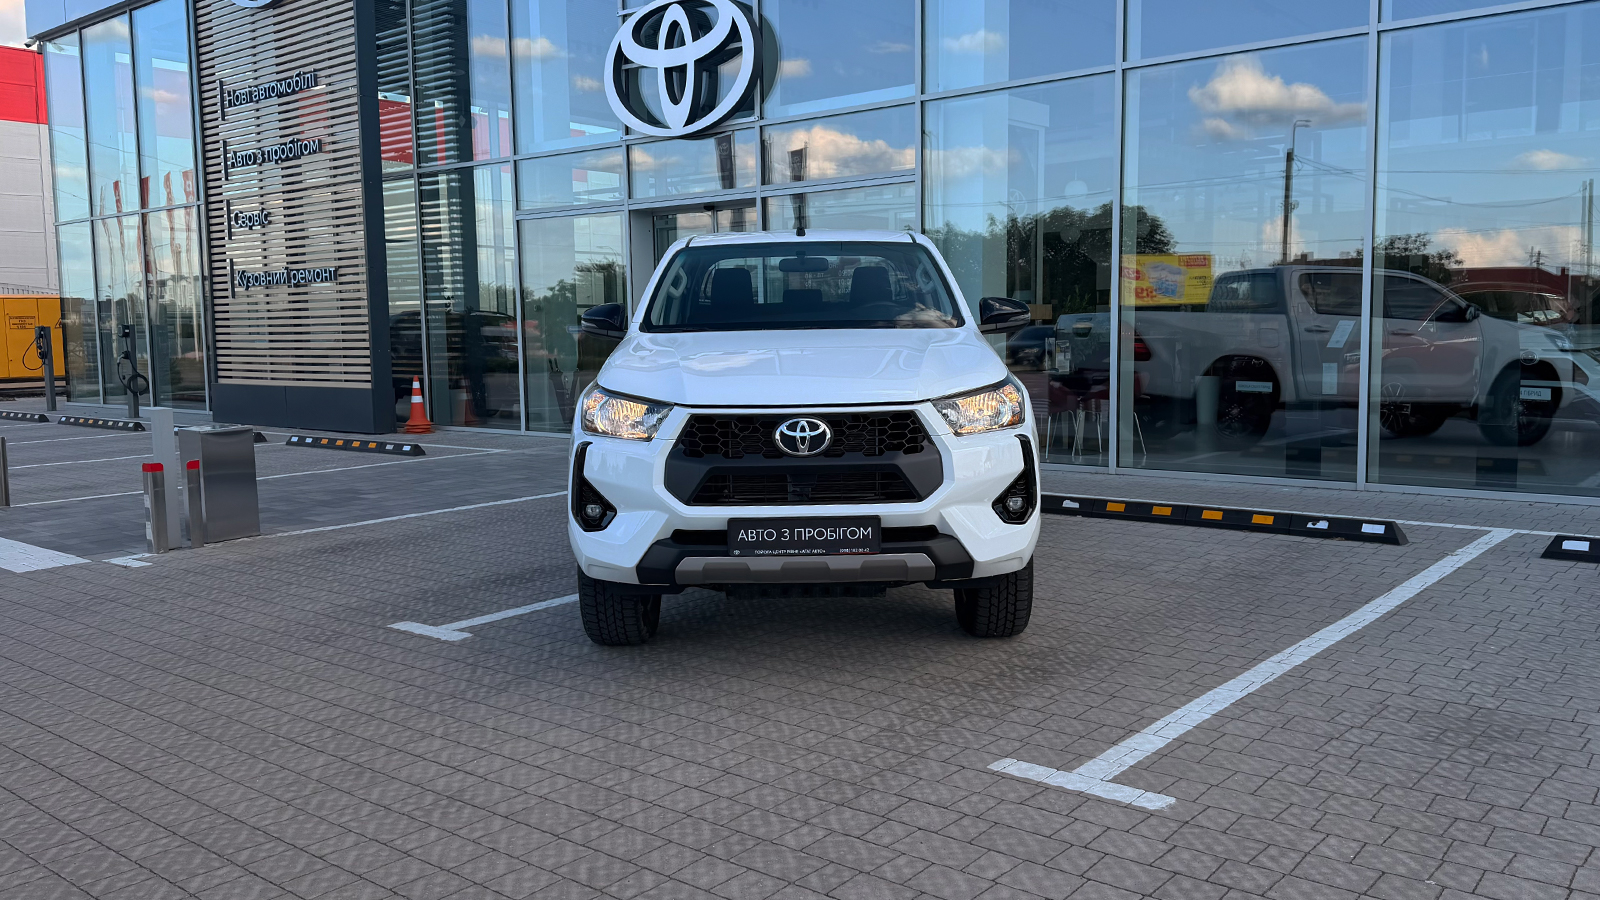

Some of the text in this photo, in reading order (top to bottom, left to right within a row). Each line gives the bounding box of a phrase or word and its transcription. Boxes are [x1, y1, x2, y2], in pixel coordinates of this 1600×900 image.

[226, 68, 318, 107] Нові автомобілі
[229, 150, 254, 168] Авто
[265, 138, 320, 164] пробігом
[232, 206, 269, 229] Сервіс
[237, 267, 336, 290] Кузовний ремонт
[737, 527, 872, 542] АВТО З ПРОБІГОМ
